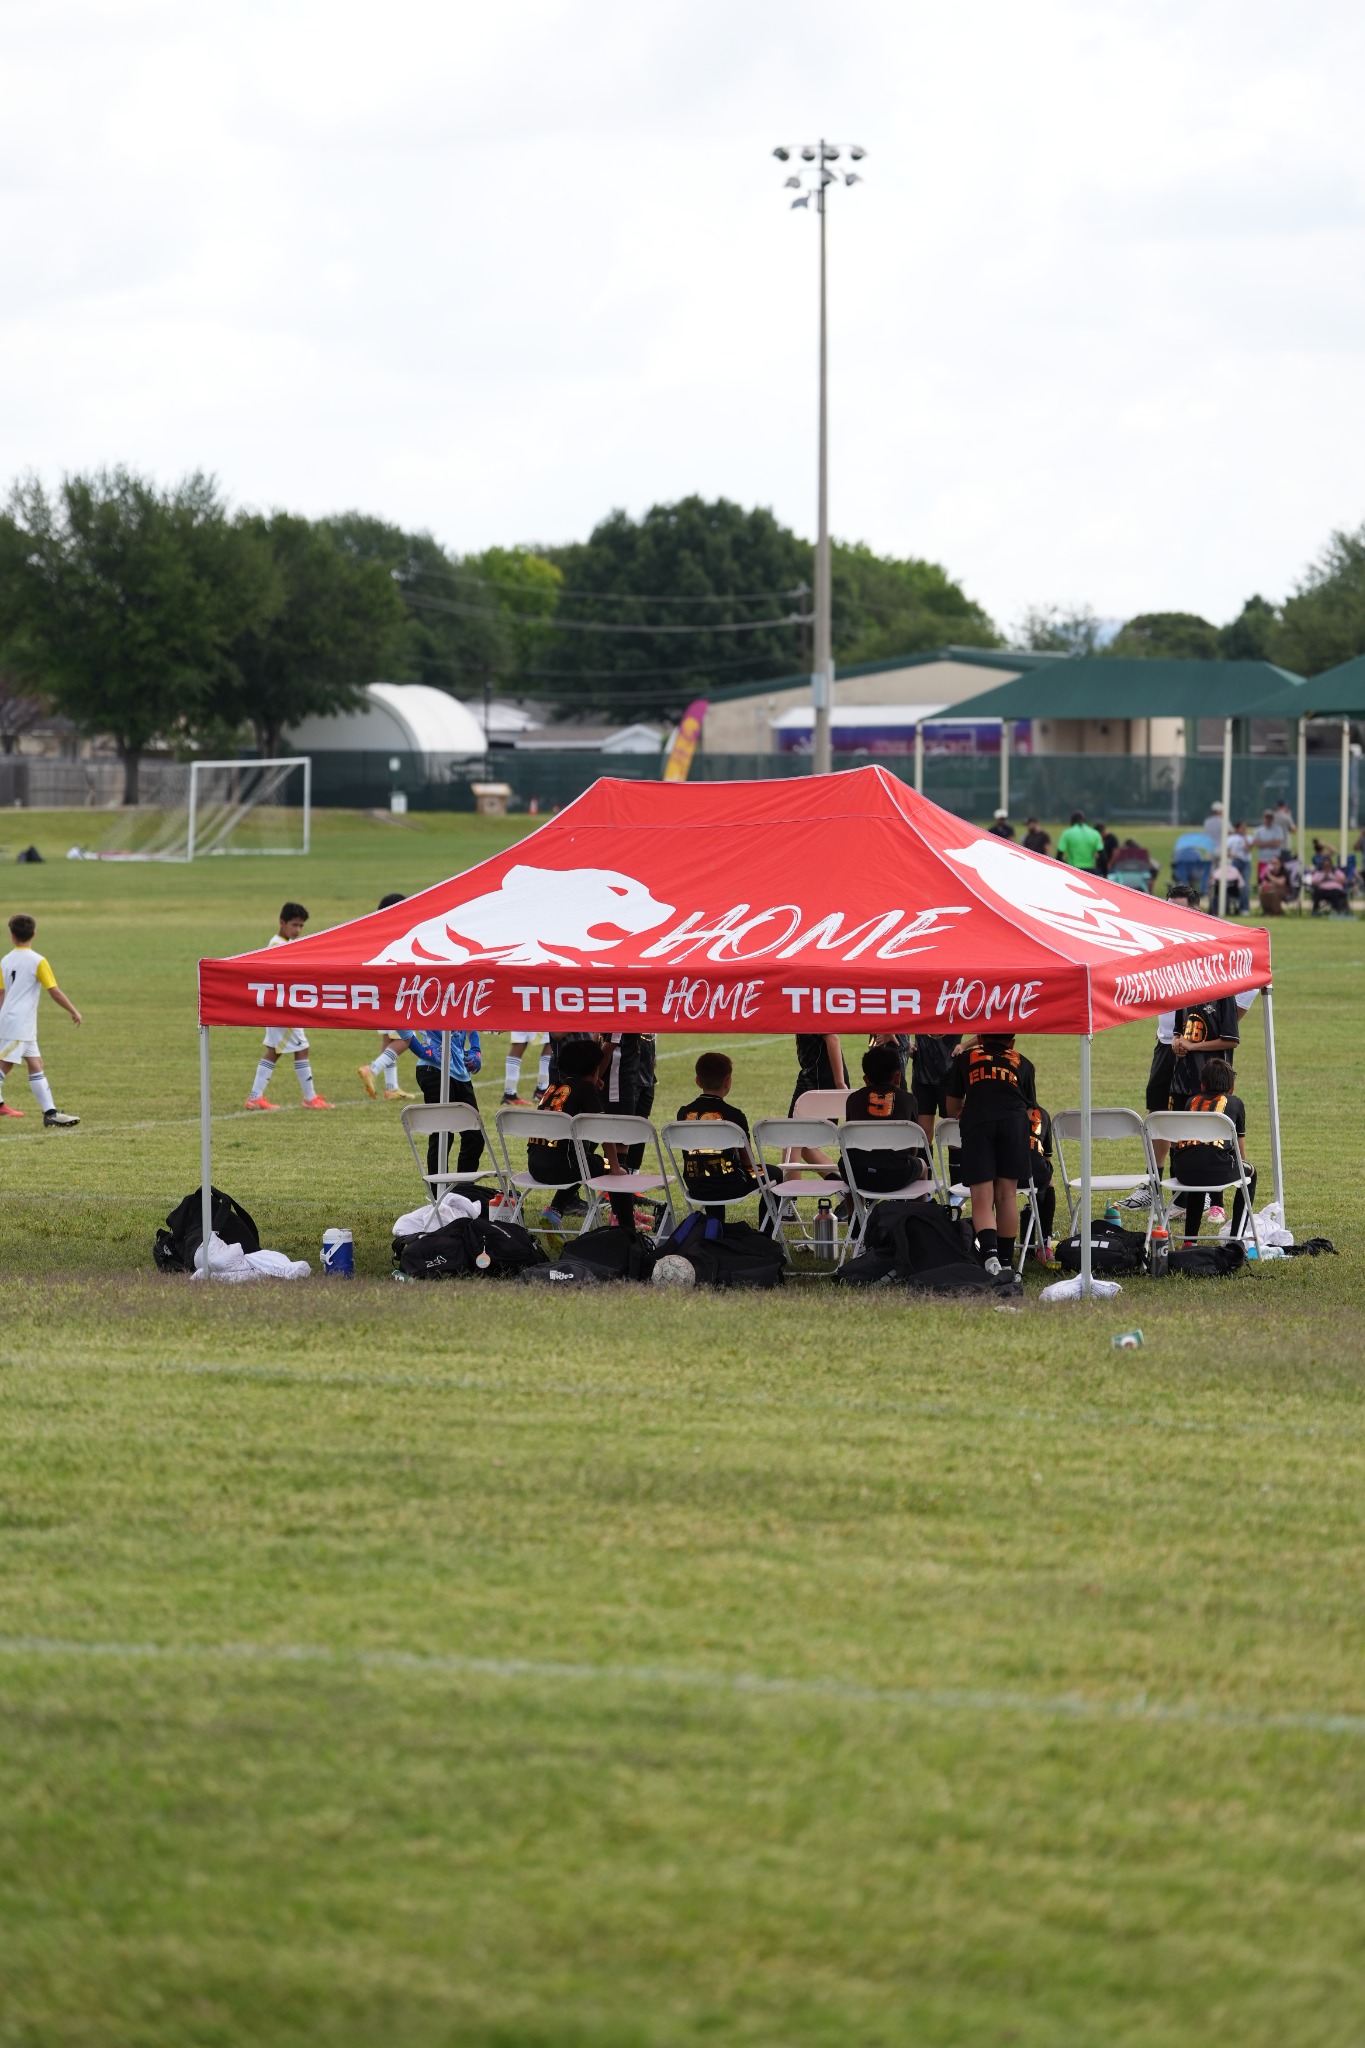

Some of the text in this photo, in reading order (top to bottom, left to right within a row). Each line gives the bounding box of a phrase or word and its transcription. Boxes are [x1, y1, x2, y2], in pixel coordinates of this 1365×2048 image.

[638, 904, 973, 965] HOME
[248, 974, 1043, 1023] TIGER HOME TIGER HOME TIGER HOME
[1114, 948, 1254, 1008] TIGERTOURNAMENTS.COM
